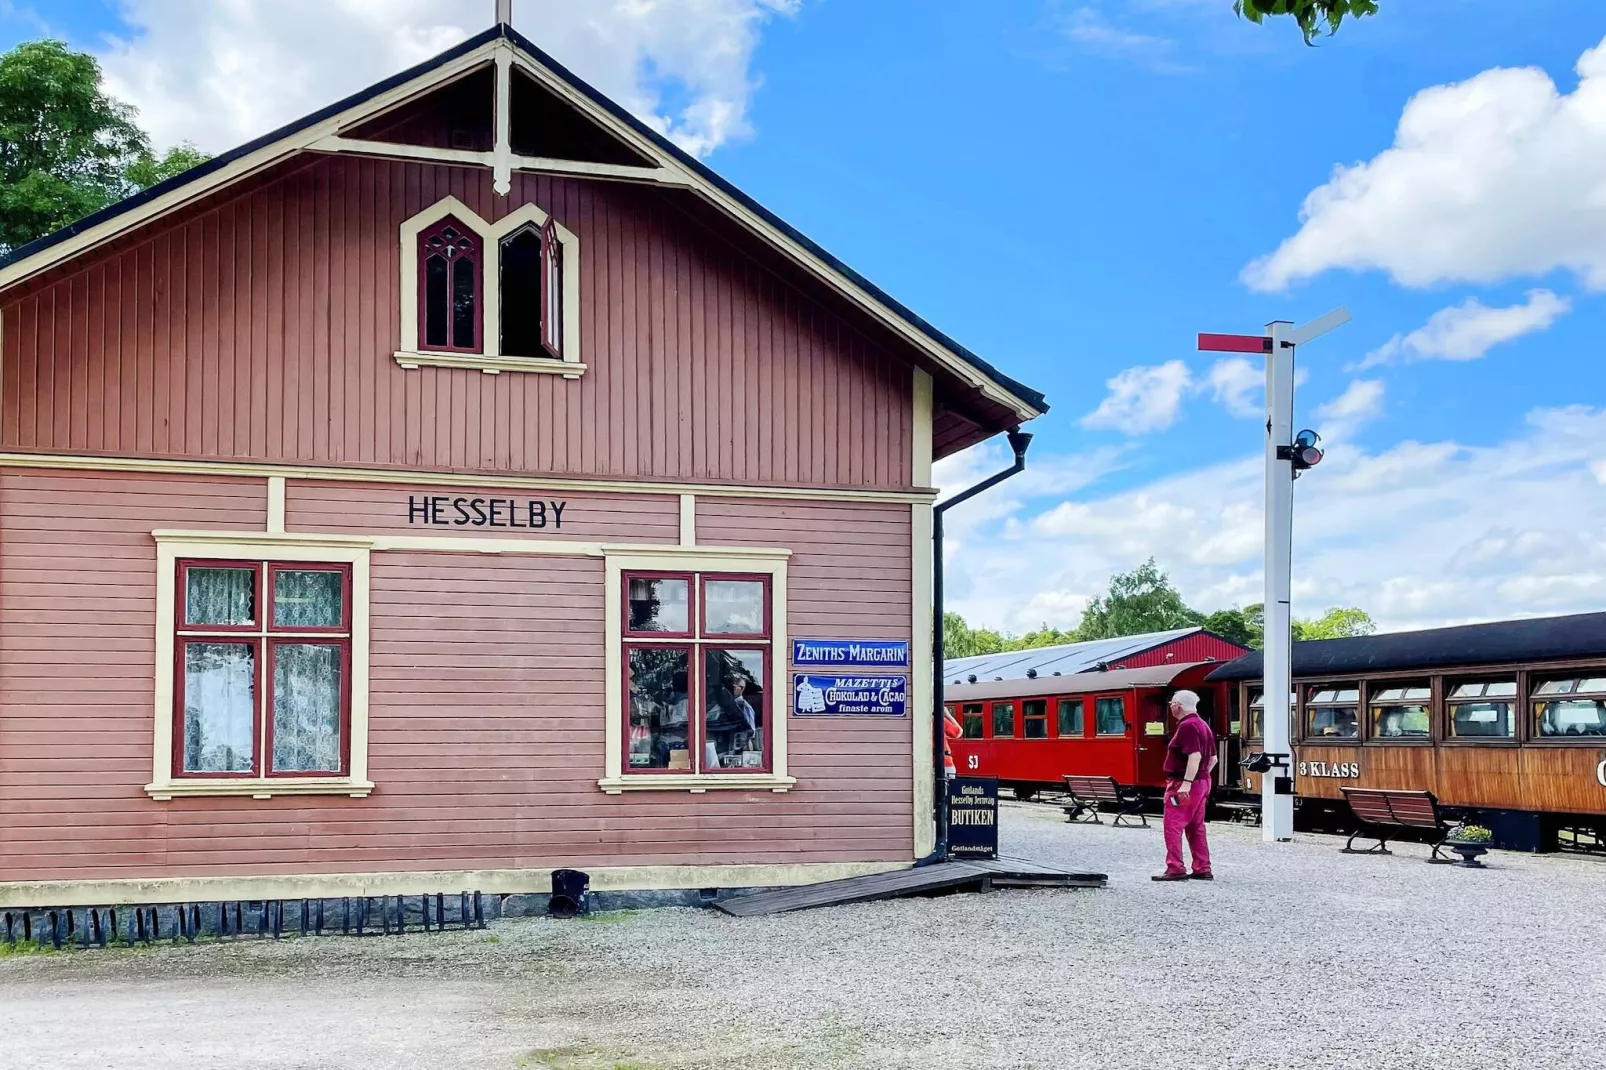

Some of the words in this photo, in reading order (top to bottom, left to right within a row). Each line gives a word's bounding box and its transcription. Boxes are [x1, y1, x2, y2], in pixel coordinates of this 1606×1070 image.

[408, 495, 567, 529] HESSELBY
[796, 643, 845, 661] ZENITHS
[848, 644, 905, 662] MARGARIN
[825, 687, 870, 706] CHOKOLAD
[871, 691, 878, 702] &
[878, 687, 905, 706] CACAO
[838, 704, 869, 713] finaste
[871, 705, 893, 713] arom
[968, 755, 979, 769] SJ
[1299, 761, 1307, 776] 3
[1310, 761, 1360, 778] KLASS
[951, 809, 994, 826] BUTIKEN
